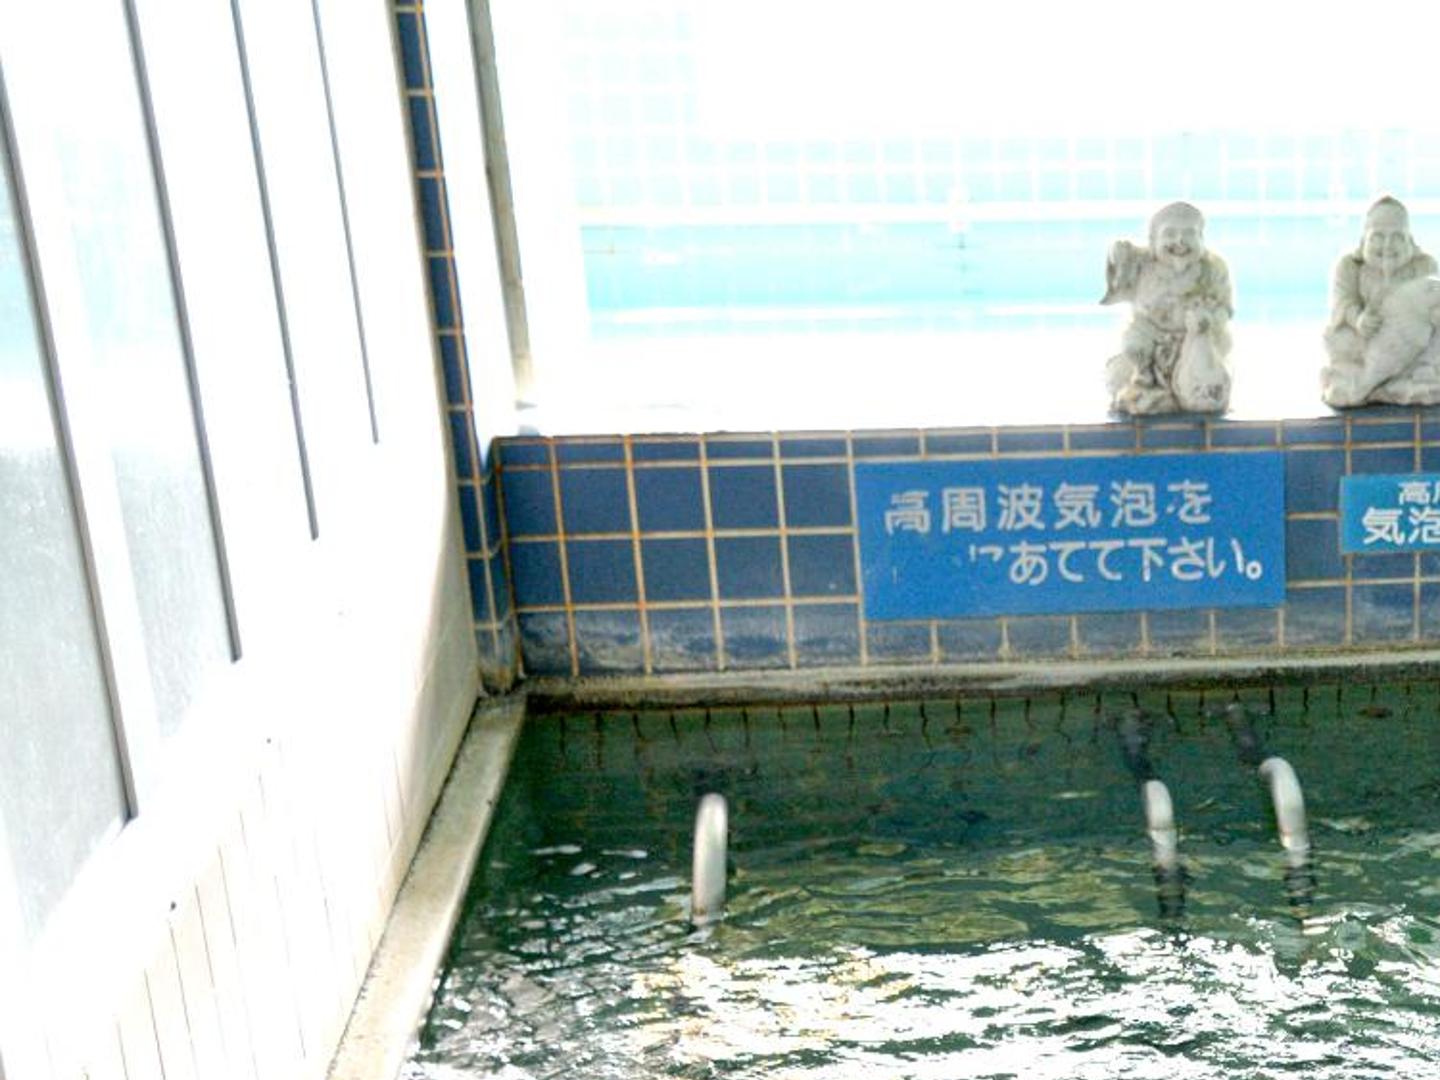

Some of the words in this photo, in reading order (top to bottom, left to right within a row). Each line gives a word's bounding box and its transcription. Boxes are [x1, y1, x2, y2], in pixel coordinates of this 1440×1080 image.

[884, 480, 1213, 534] 高周波気泡を
